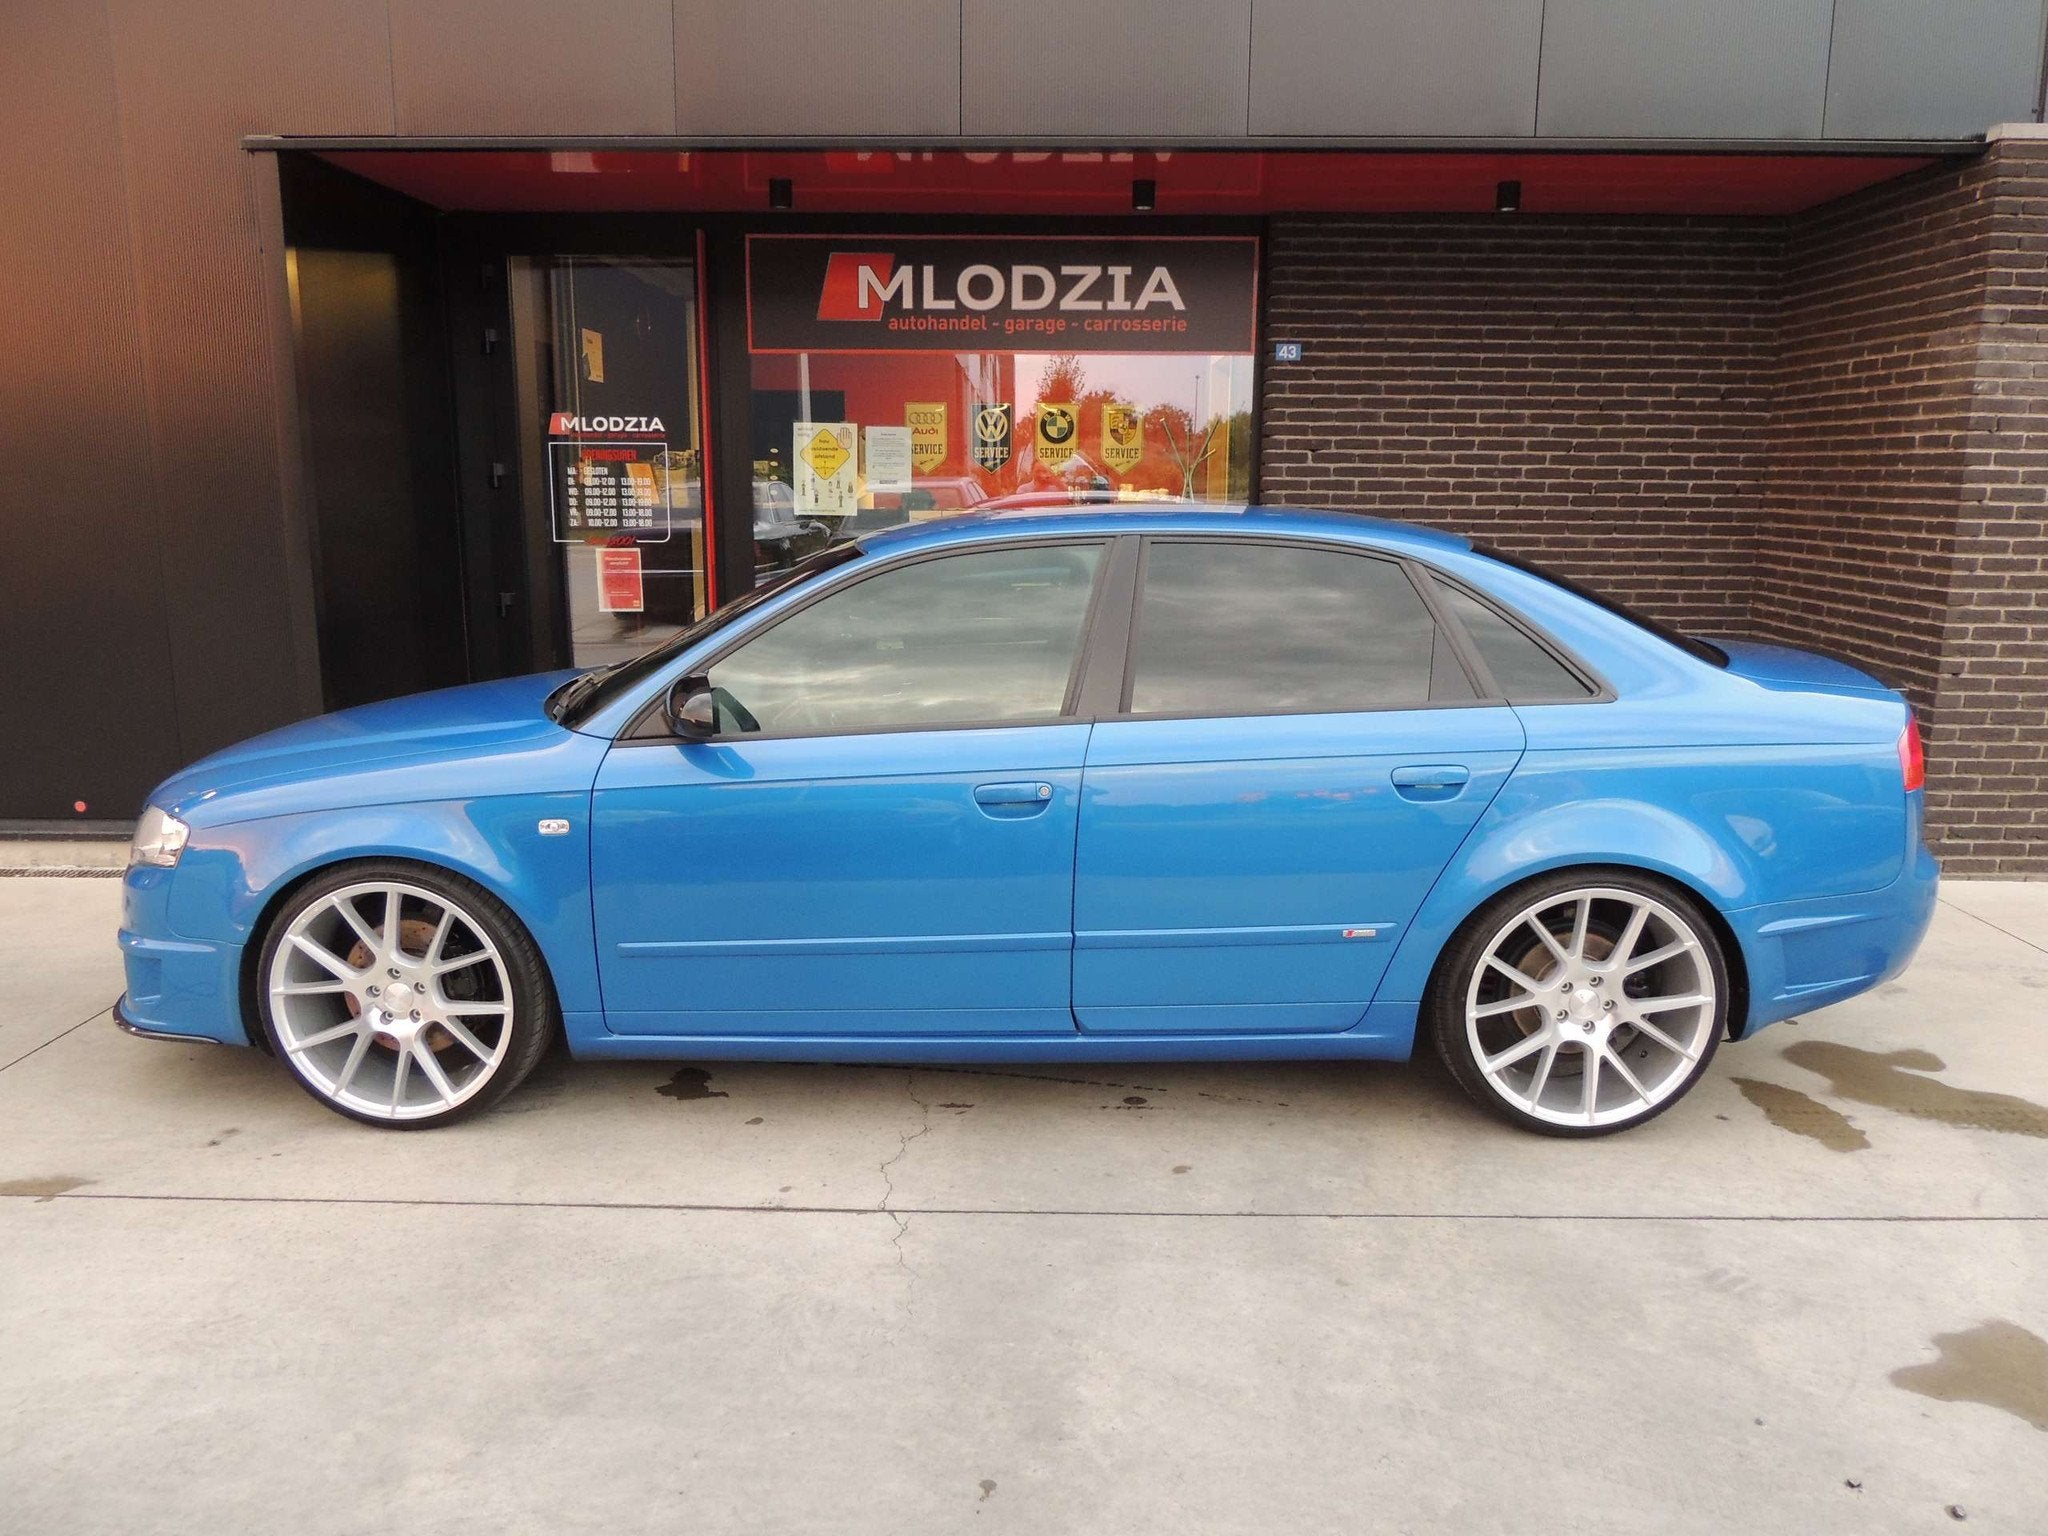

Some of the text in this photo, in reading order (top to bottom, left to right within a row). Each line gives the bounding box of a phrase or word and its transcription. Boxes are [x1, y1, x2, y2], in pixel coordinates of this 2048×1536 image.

[858, 264, 1186, 311] MLODZIA
[888, 314, 987, 331] autohandel
[1004, 317, 1066, 334] garage
[1084, 316, 1188, 332] carrosserie
[1279, 345, 1297, 359] 43
[560, 416, 666, 432] MLODZIA
[913, 427, 939, 435] Audi
[974, 446, 1009, 459] SERVICE
[1104, 447, 1140, 459] SERVICE
